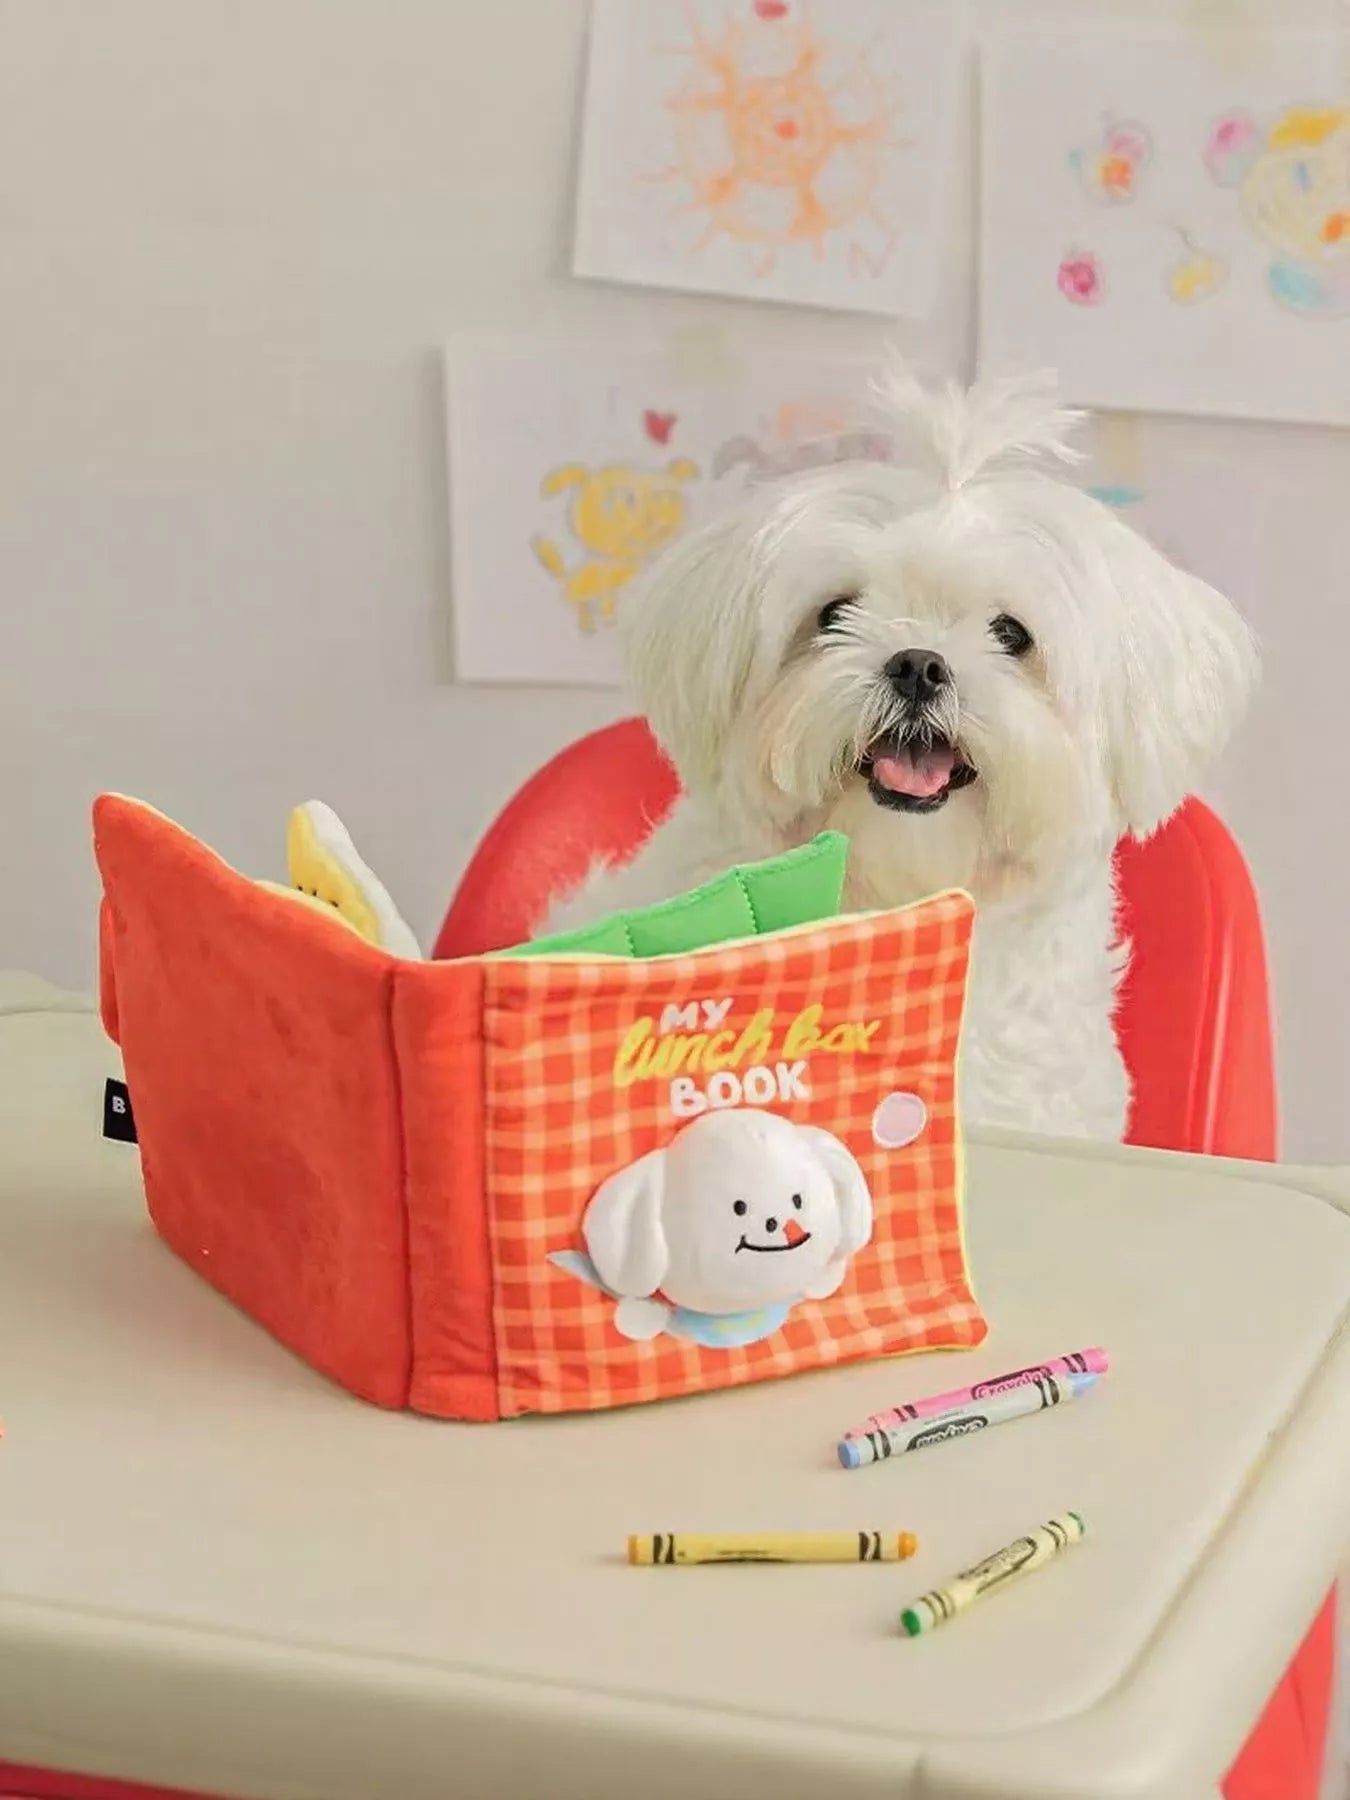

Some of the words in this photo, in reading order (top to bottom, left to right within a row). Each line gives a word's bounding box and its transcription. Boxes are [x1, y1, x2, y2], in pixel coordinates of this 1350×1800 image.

[661, 998, 732, 1034] MY
[615, 1008, 774, 1086] lunch
[784, 1005, 880, 1056] box
[671, 1062, 809, 1115] BOOK
